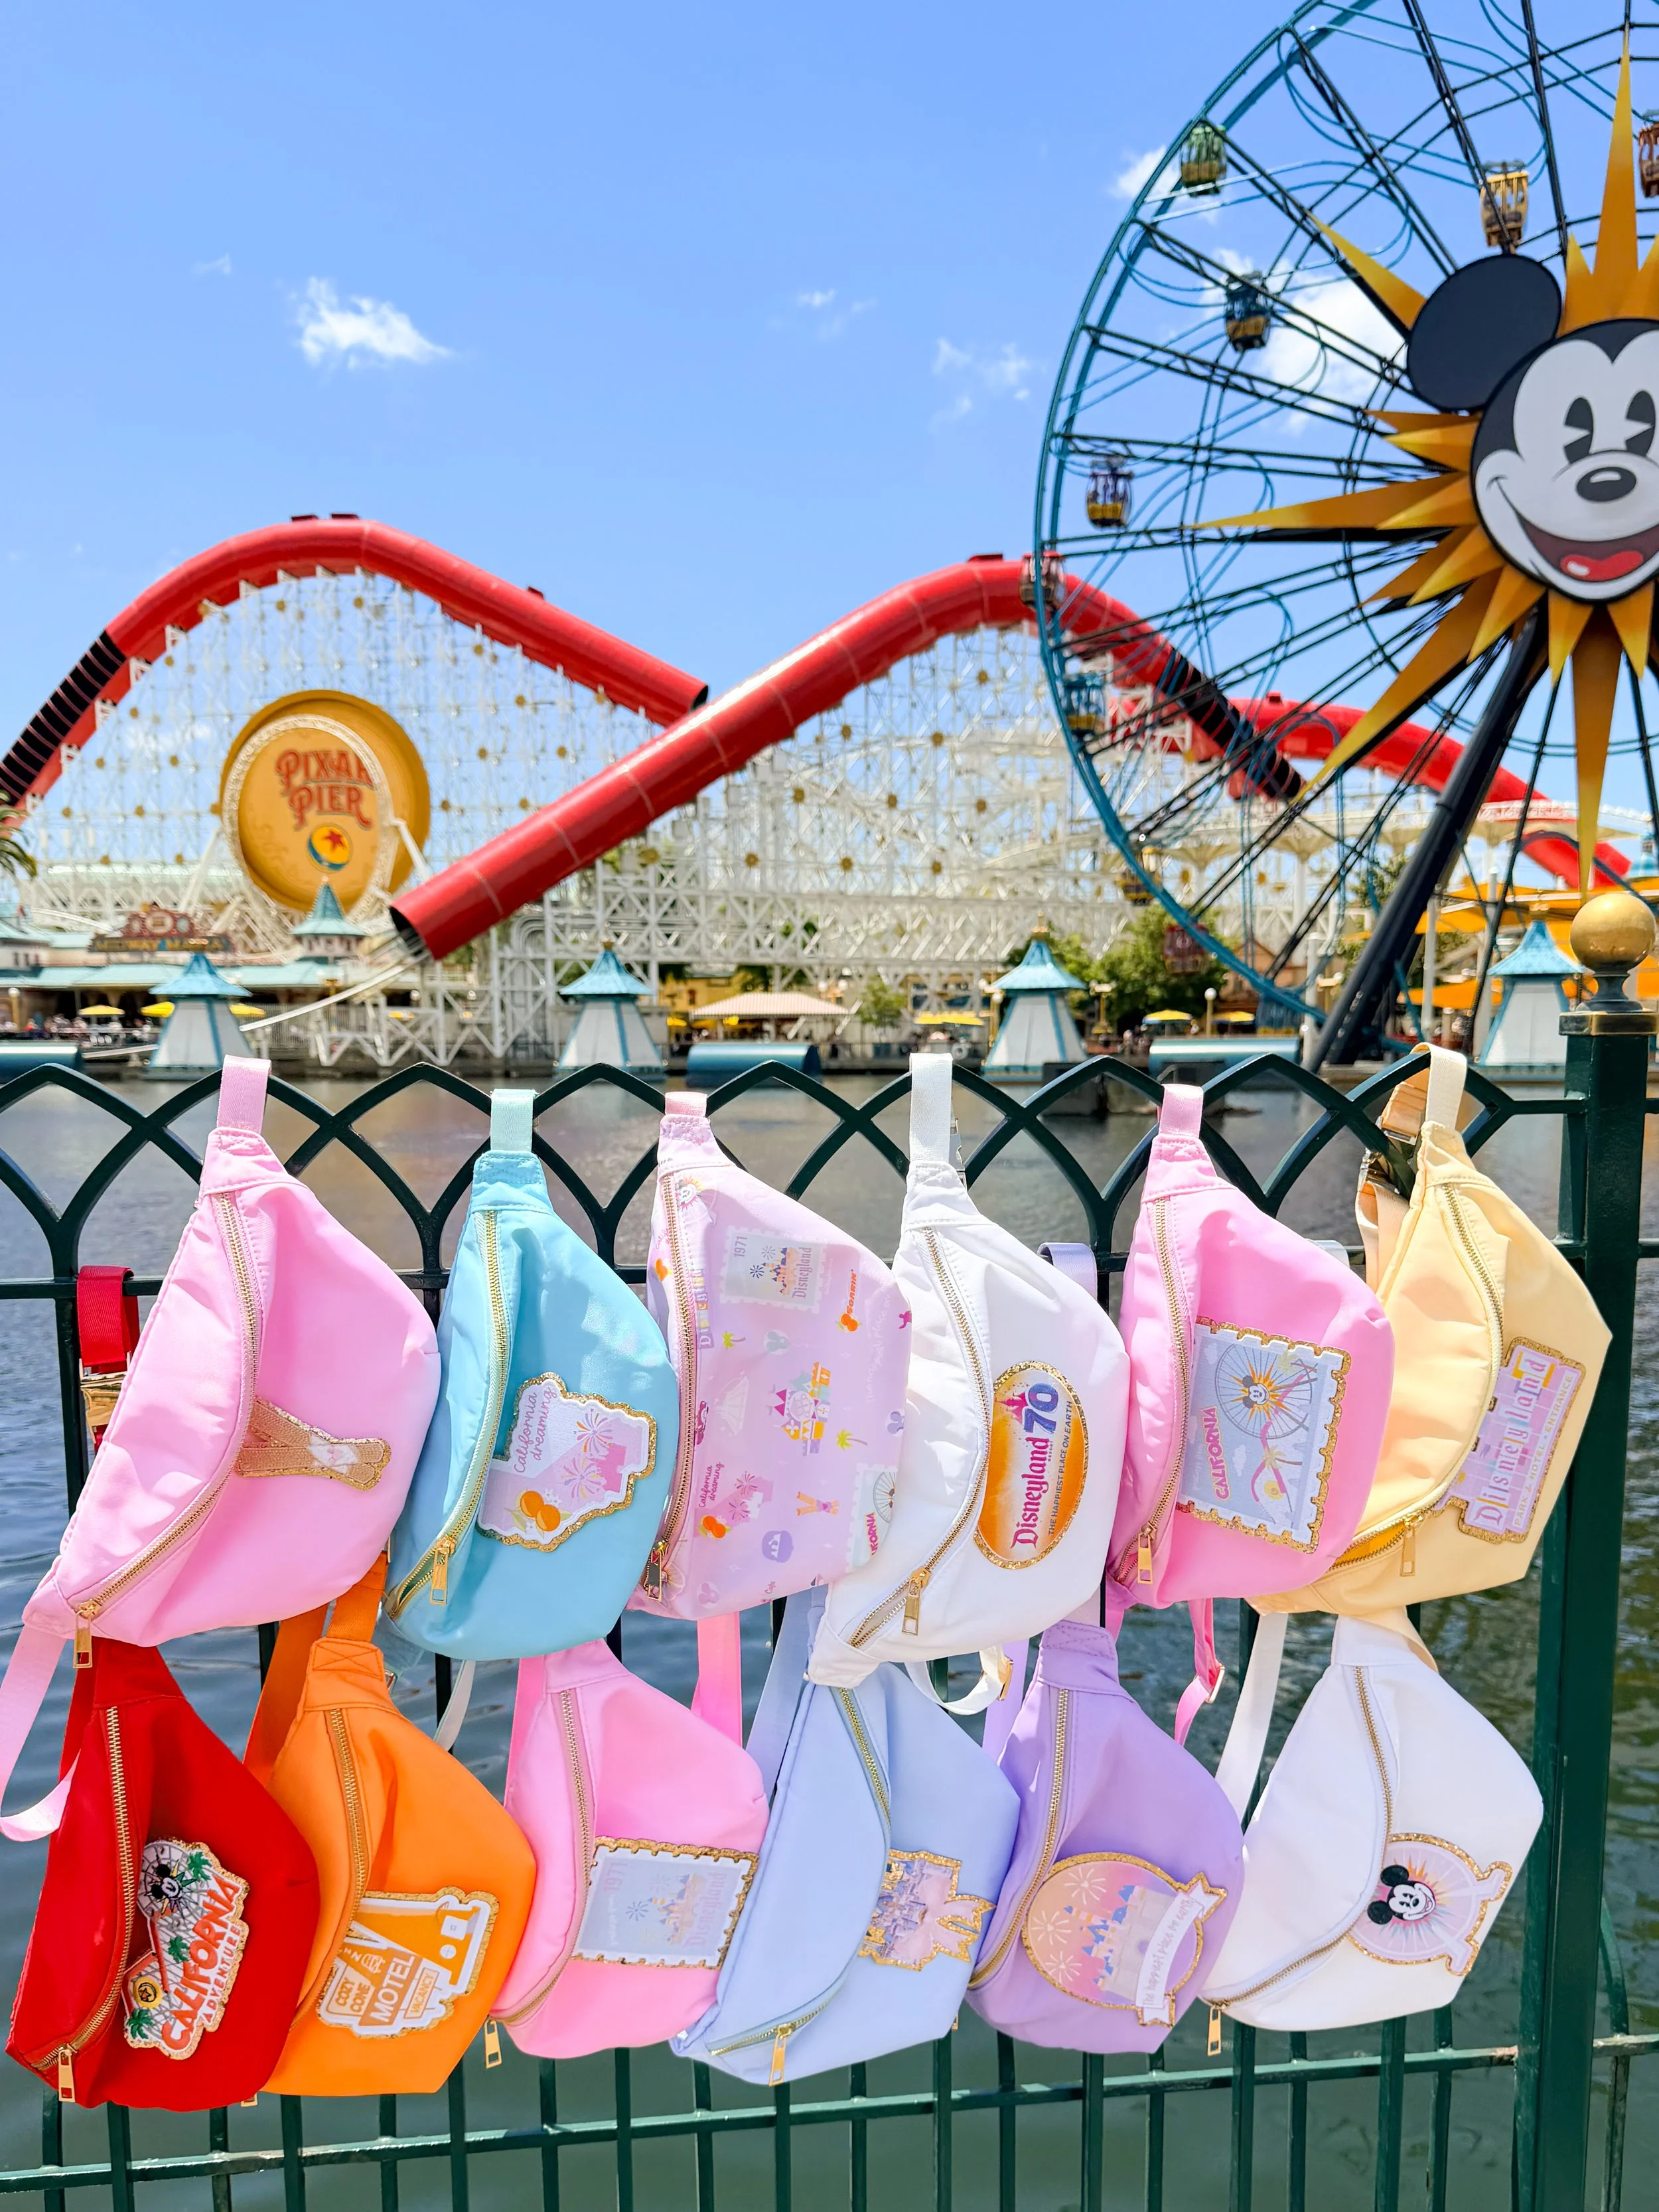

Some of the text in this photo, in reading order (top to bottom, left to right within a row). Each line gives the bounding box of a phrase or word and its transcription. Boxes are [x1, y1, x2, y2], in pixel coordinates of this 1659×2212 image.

[289, 786, 372, 829] PIER
[733, 1236, 748, 1258] 1971
[792, 1247, 812, 1299] Disneyland
[531, 1387, 557, 1461] dreaming
[1023, 1382, 1059, 1434] 70
[514, 1392, 538, 1473] California
[1062, 1435, 1070, 1448] ON
[1200, 1408, 1229, 1500] CALIFORNIA
[1473, 1359, 1547, 1525] Disneyland
[1514, 1496, 1528, 1526] PARK
[1529, 1444, 1546, 1480] HOTEL
[1545, 1376, 1572, 1432] ENTRANCE
[710, 1461, 725, 1501] dreaming
[1058, 1448, 1067, 1473] PLACE
[699, 1465, 713, 1509] California
[1010, 1437, 1049, 1549] Disneyland
[1051, 1475, 1063, 1517] HAPPIEST
[1048, 1519, 1057, 1536] THE
[604, 1862, 628, 1893] 1971
[682, 1872, 727, 1947] Disneyland
[161, 1874, 241, 2051] CALIFORNIA
[201, 1925, 242, 2024] ADVENTURE
[1147, 1954, 1165, 1990] happiest
[336, 1978, 354, 2007] COZY
[350, 1982, 373, 2012] CONE
[370, 1955, 415, 2023] MOTEL
[410, 1972, 435, 2014] VACANCY
[1143, 1992, 1155, 2006] The
